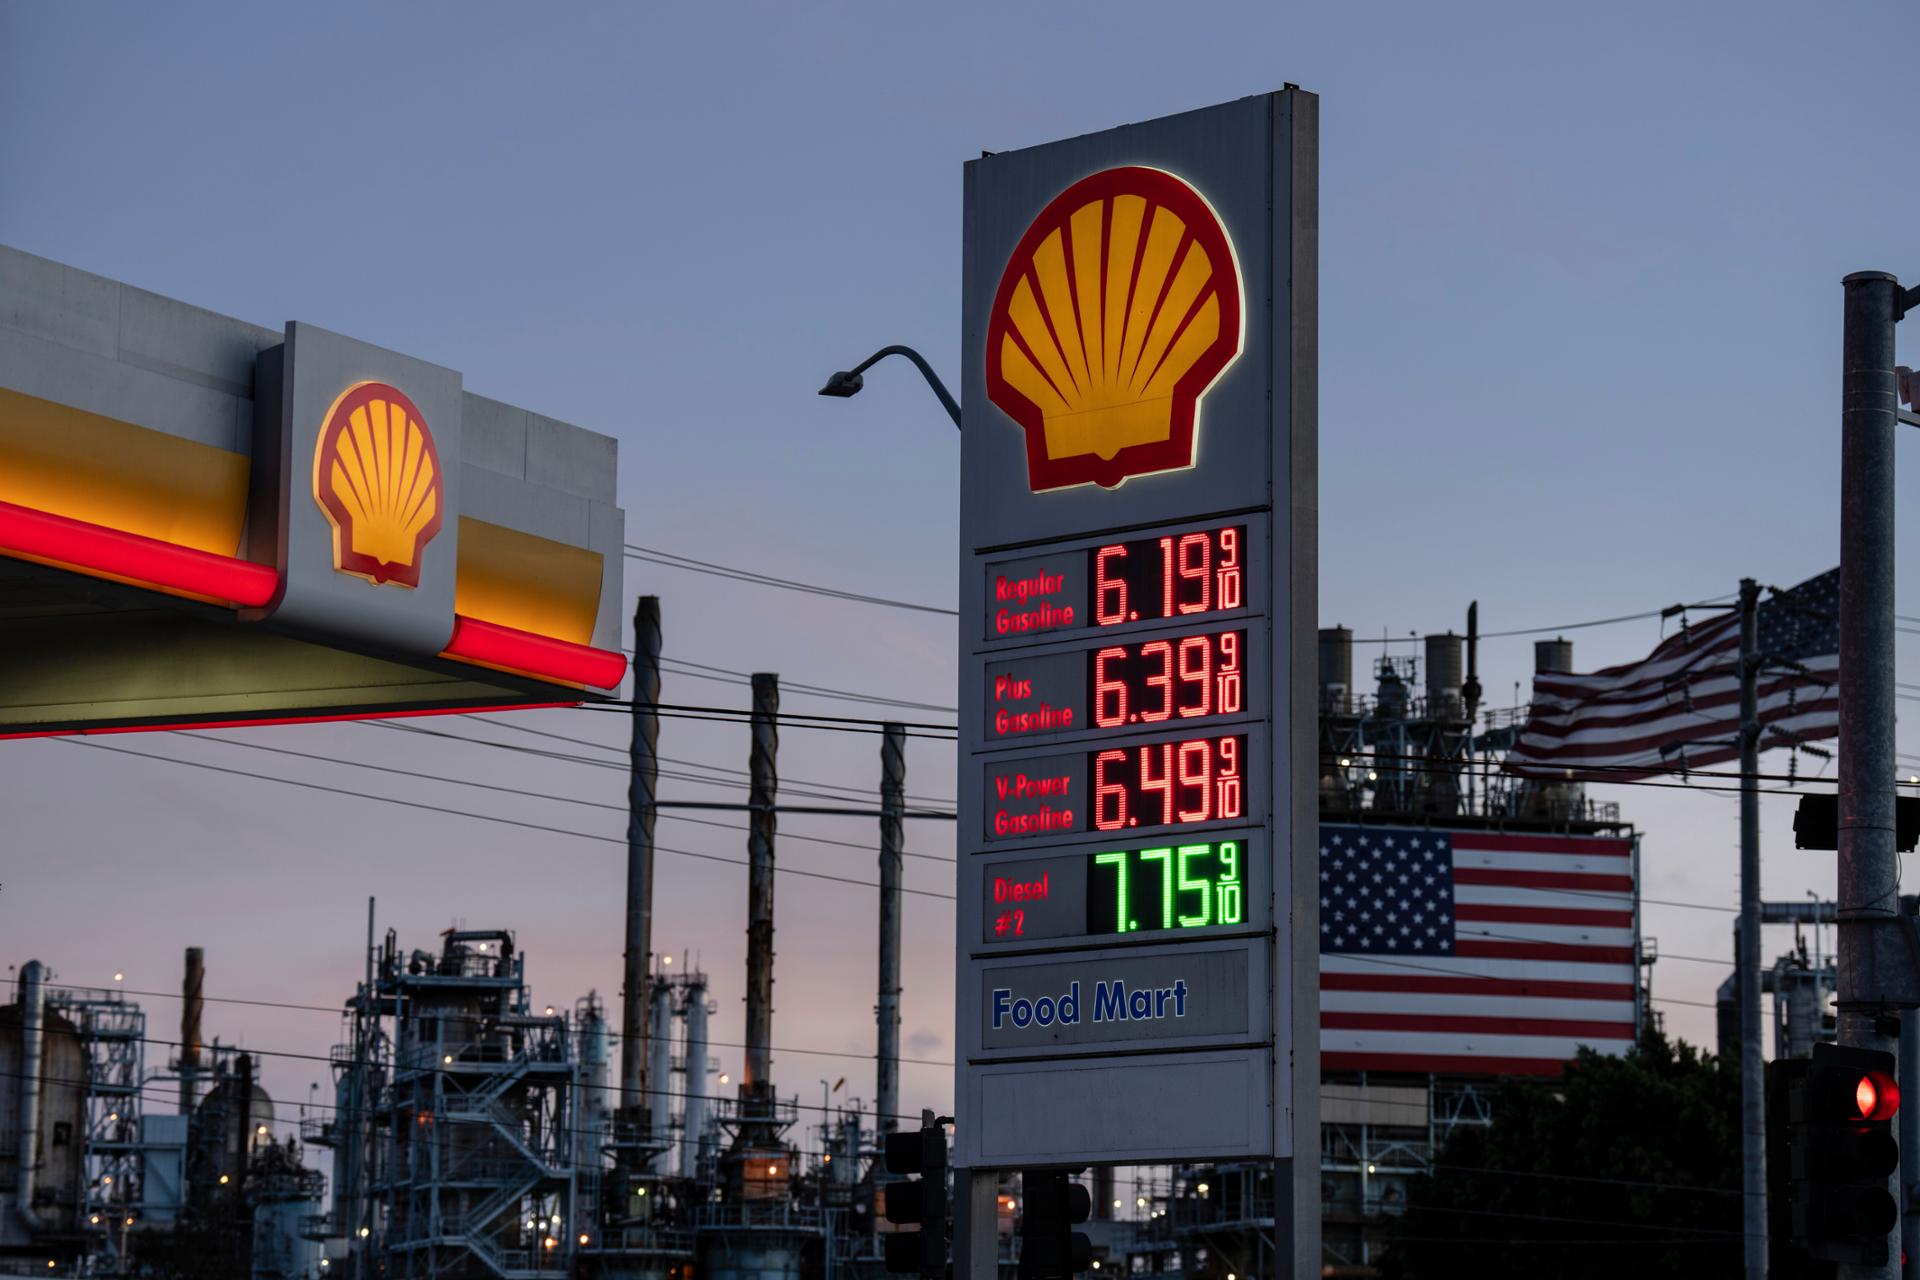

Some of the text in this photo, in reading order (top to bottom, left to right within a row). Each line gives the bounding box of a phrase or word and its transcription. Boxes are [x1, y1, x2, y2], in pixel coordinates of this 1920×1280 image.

[996, 568, 1064, 604] Regular
[996, 603, 1074, 634] Gasoline
[995, 673, 1032, 701] Plus
[995, 703, 1073, 735] Gasoline
[995, 775, 1070, 801] V-Power
[995, 804, 1073, 836] Gasoline
[994, 872, 1049, 904] Diesel
[995, 909, 1025, 937] #2
[992, 979, 1187, 1029] Food Mart
